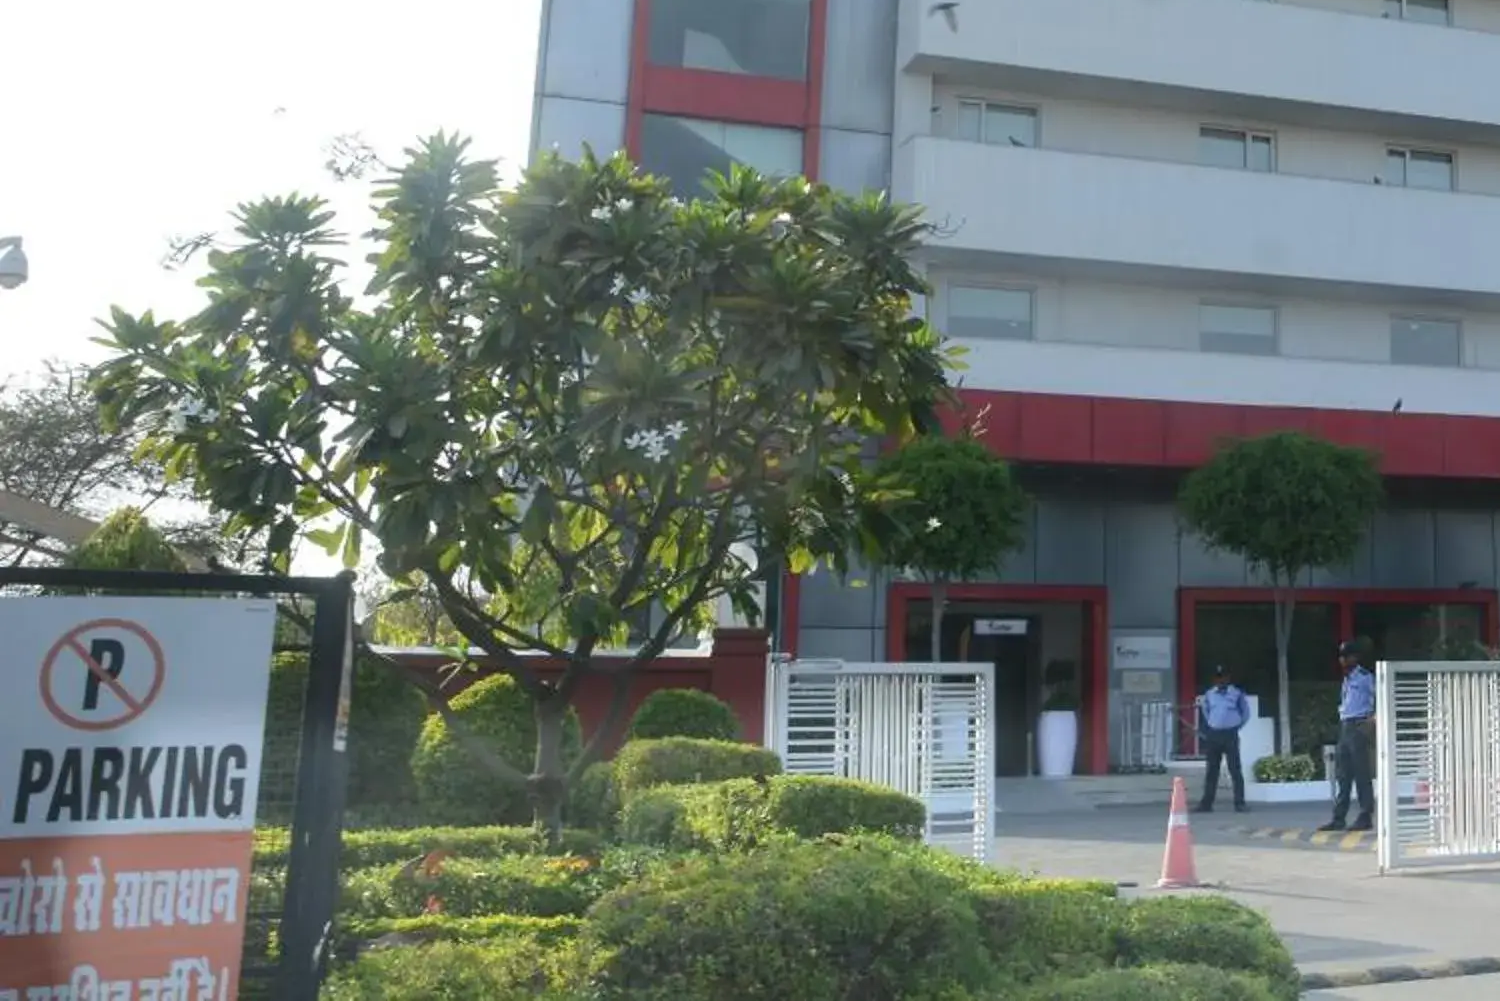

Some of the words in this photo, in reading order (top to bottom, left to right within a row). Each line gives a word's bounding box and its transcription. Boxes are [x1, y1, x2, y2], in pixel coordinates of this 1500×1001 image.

[12, 743, 248, 824] PARKING
[75, 856, 106, 931] से
[113, 867, 240, 929] सावधान
